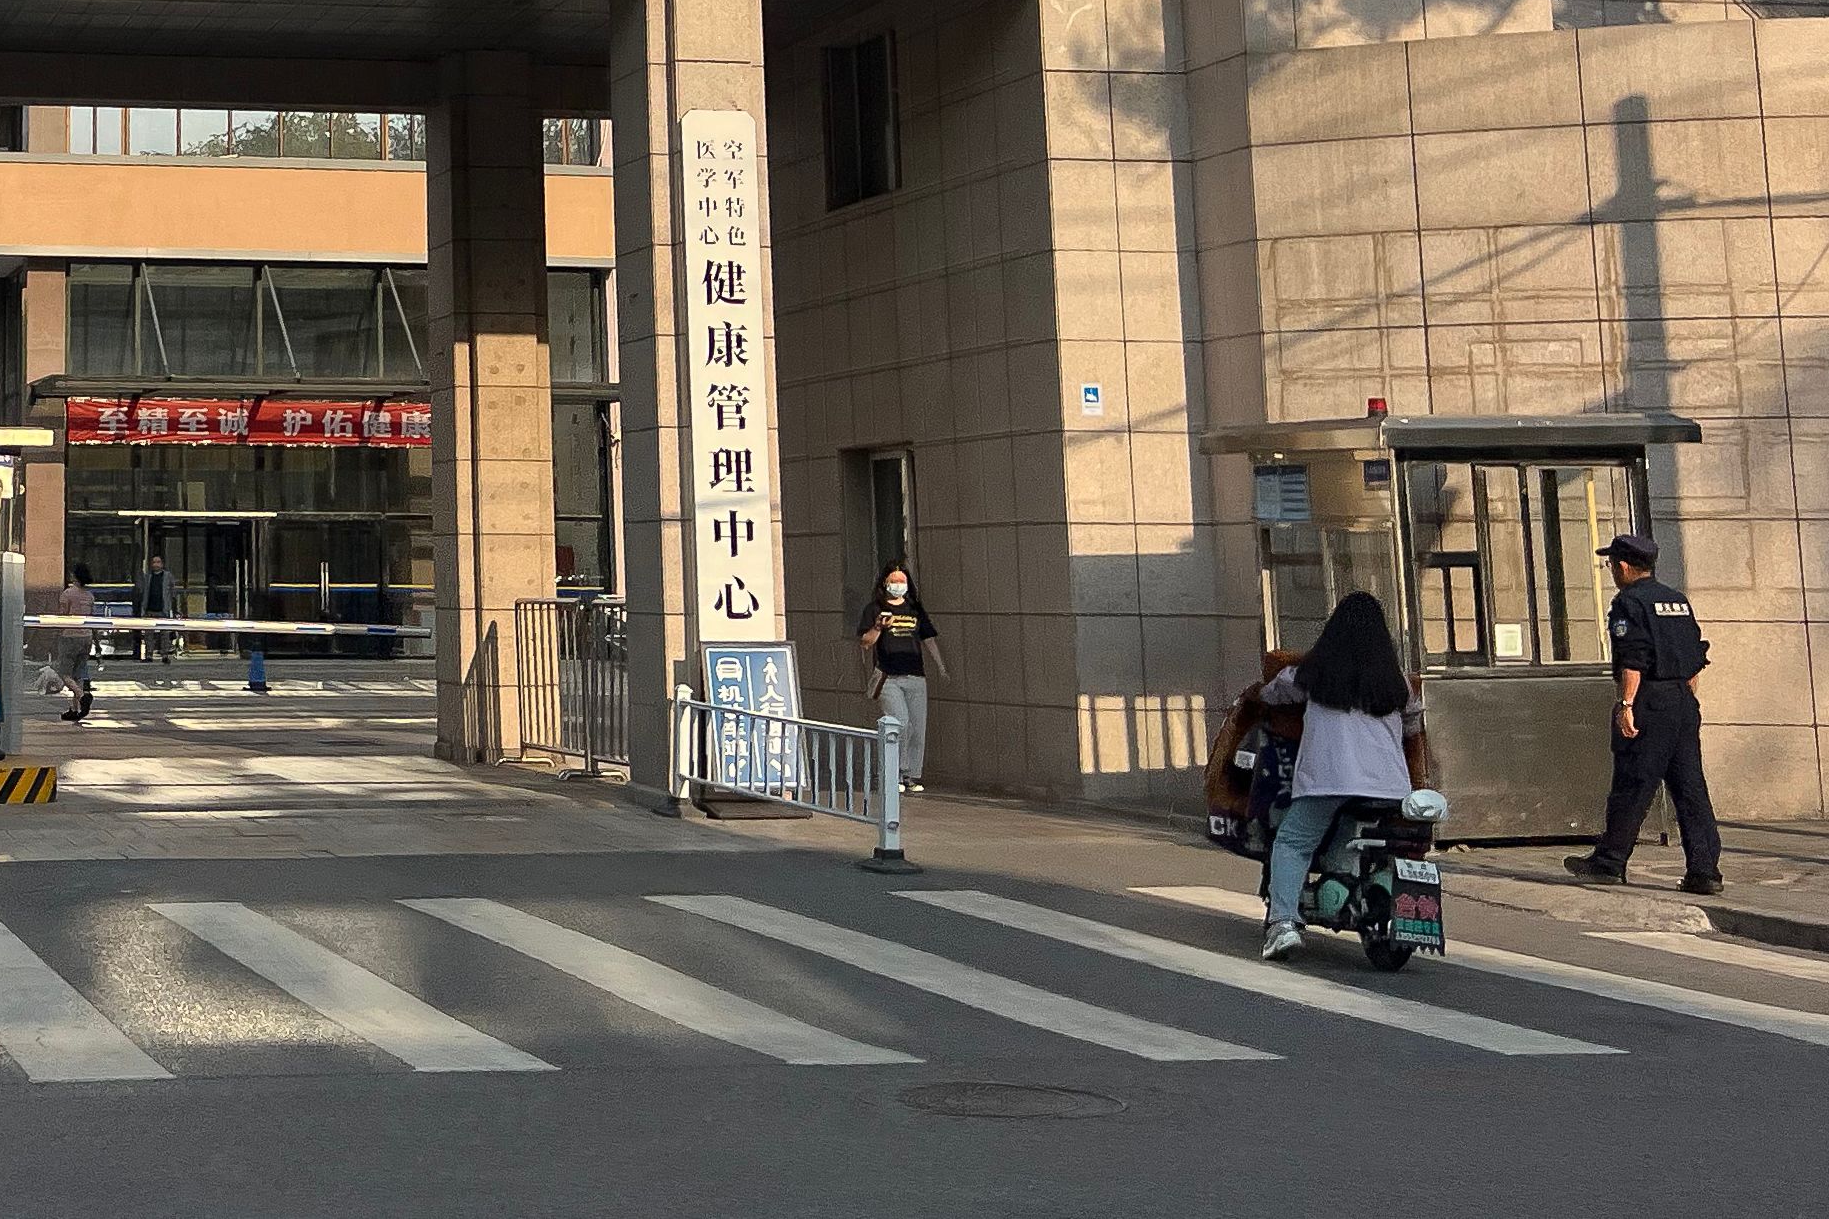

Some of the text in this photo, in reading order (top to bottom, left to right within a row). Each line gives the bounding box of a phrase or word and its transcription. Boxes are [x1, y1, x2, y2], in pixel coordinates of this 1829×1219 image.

[696, 140, 720, 245] 医学中心
[723, 140, 747, 246] 空军特色
[97, 406, 432, 440] 至精至诚 护佑健康
[702, 259, 761, 621] 健康管理中心
